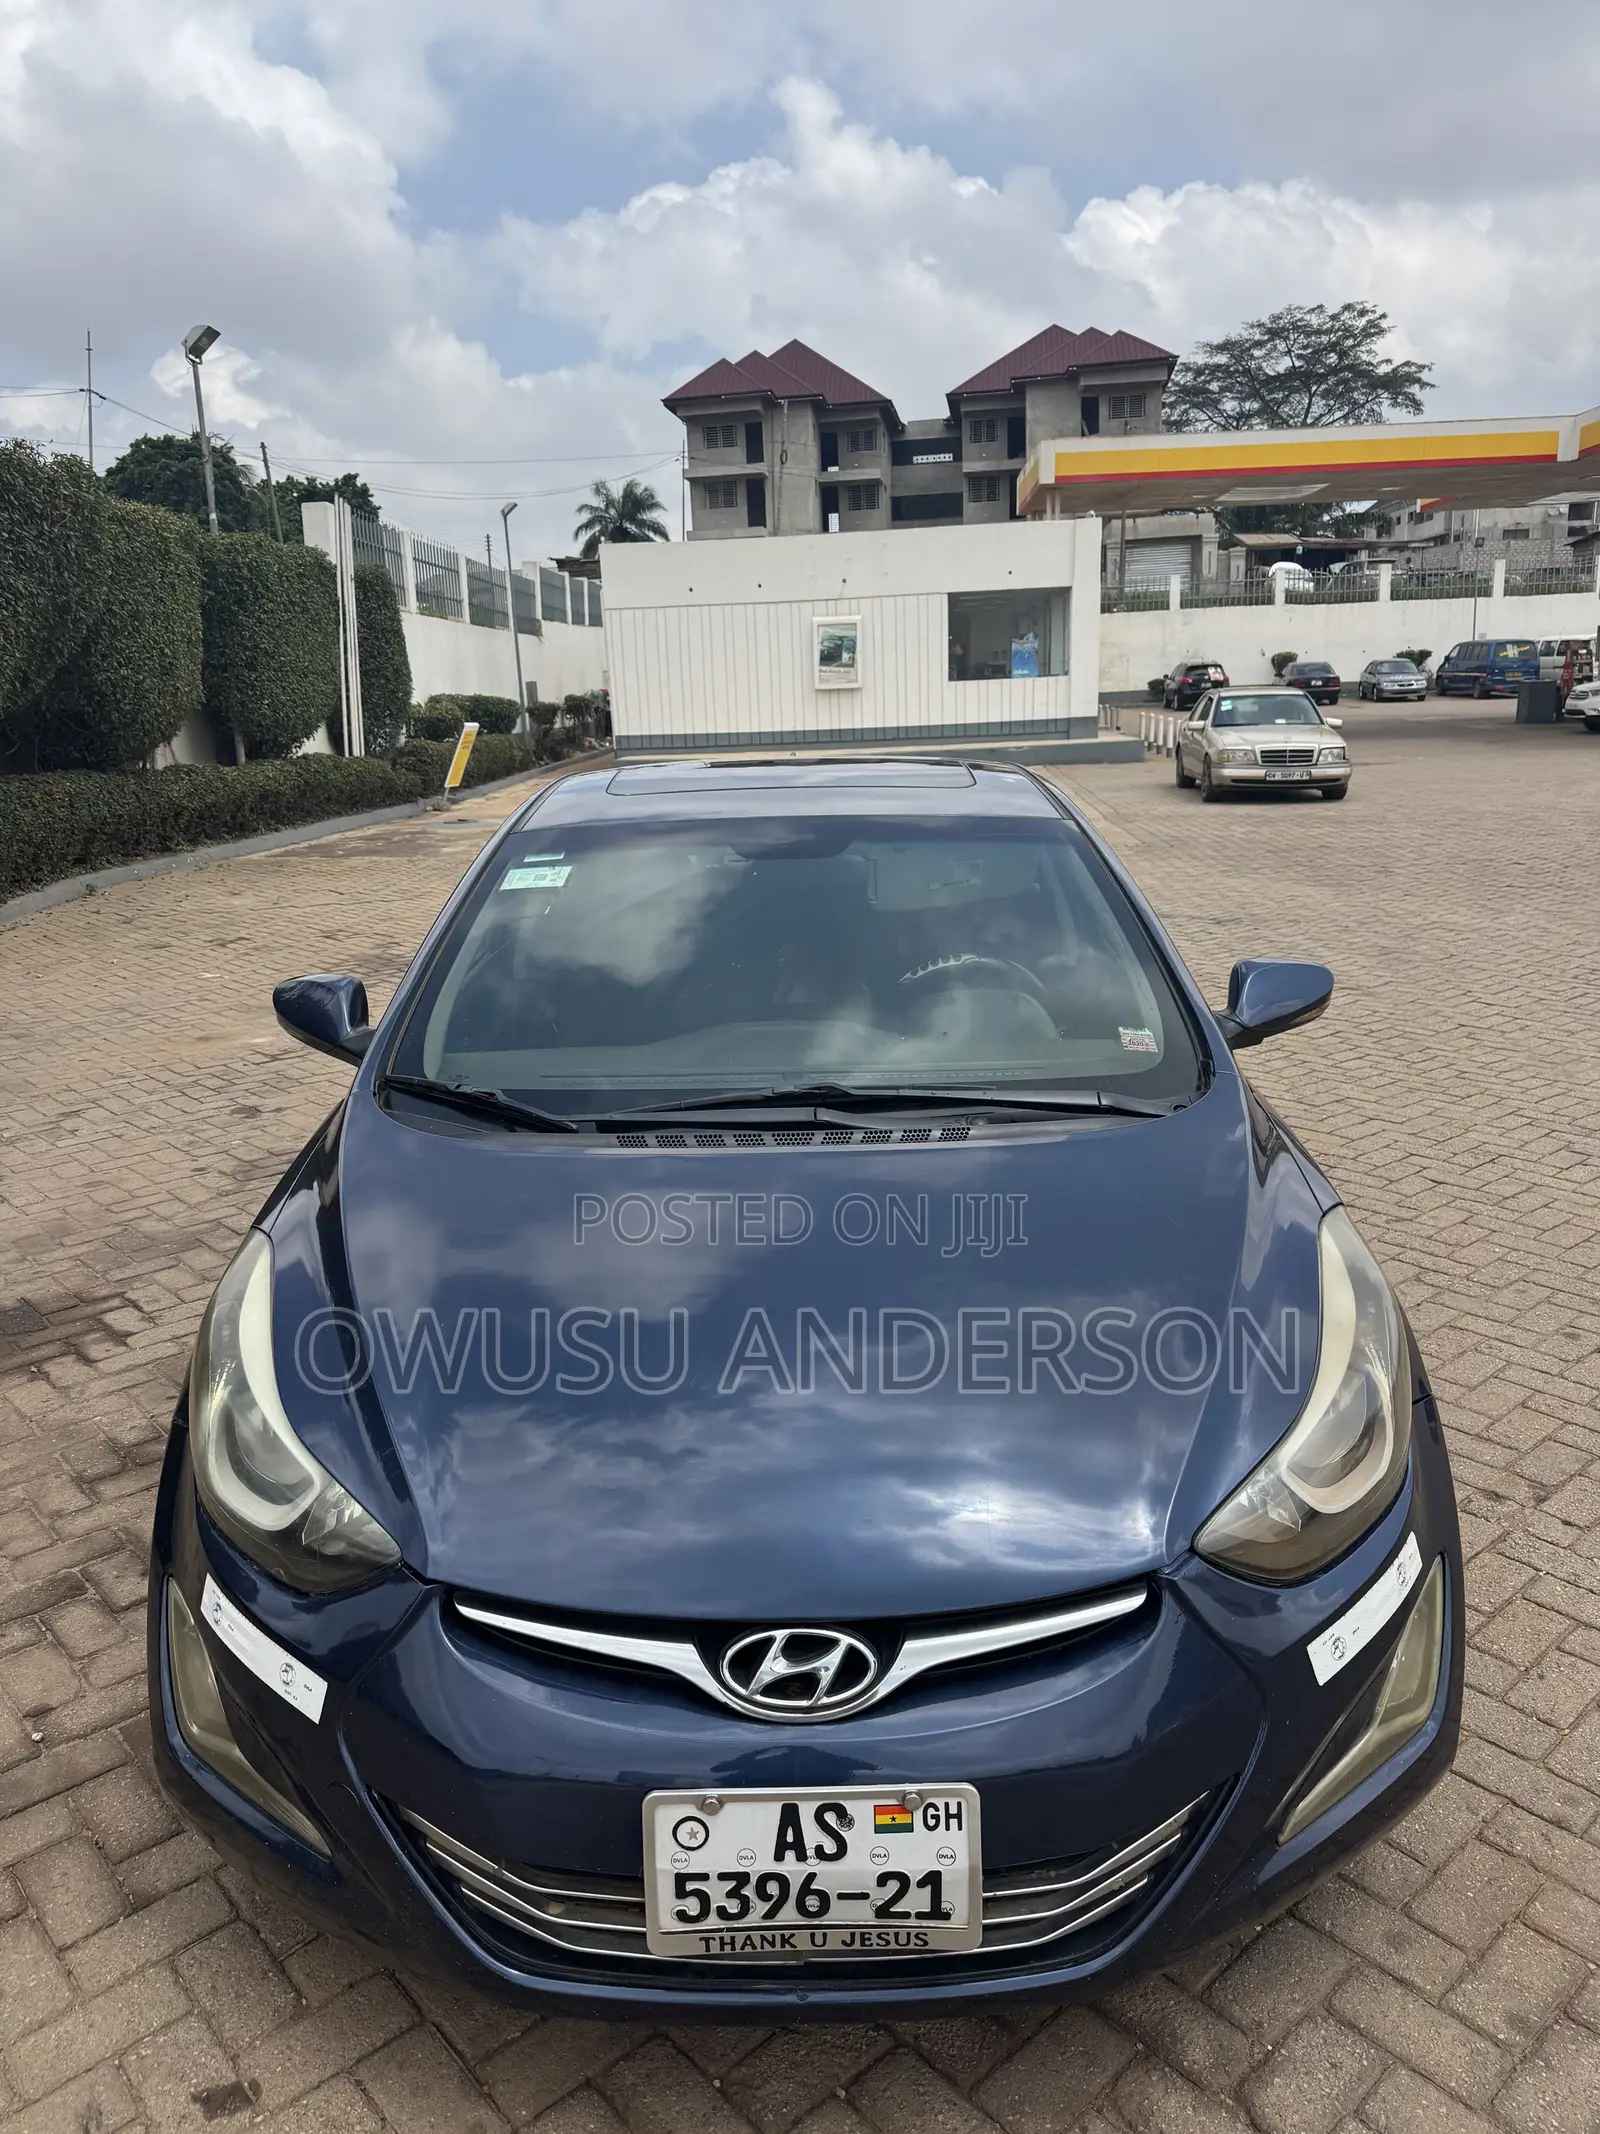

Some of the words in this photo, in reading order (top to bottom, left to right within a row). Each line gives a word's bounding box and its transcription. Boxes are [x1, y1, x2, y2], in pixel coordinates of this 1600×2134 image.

[774, 1802, 848, 1862] AS
[922, 1801, 963, 1832] GH
[674, 1869, 951, 1924] 5396-21
[699, 1933, 798, 1954] THANK
[810, 1932, 828, 1949] U
[841, 1931, 930, 1949] JESUS
